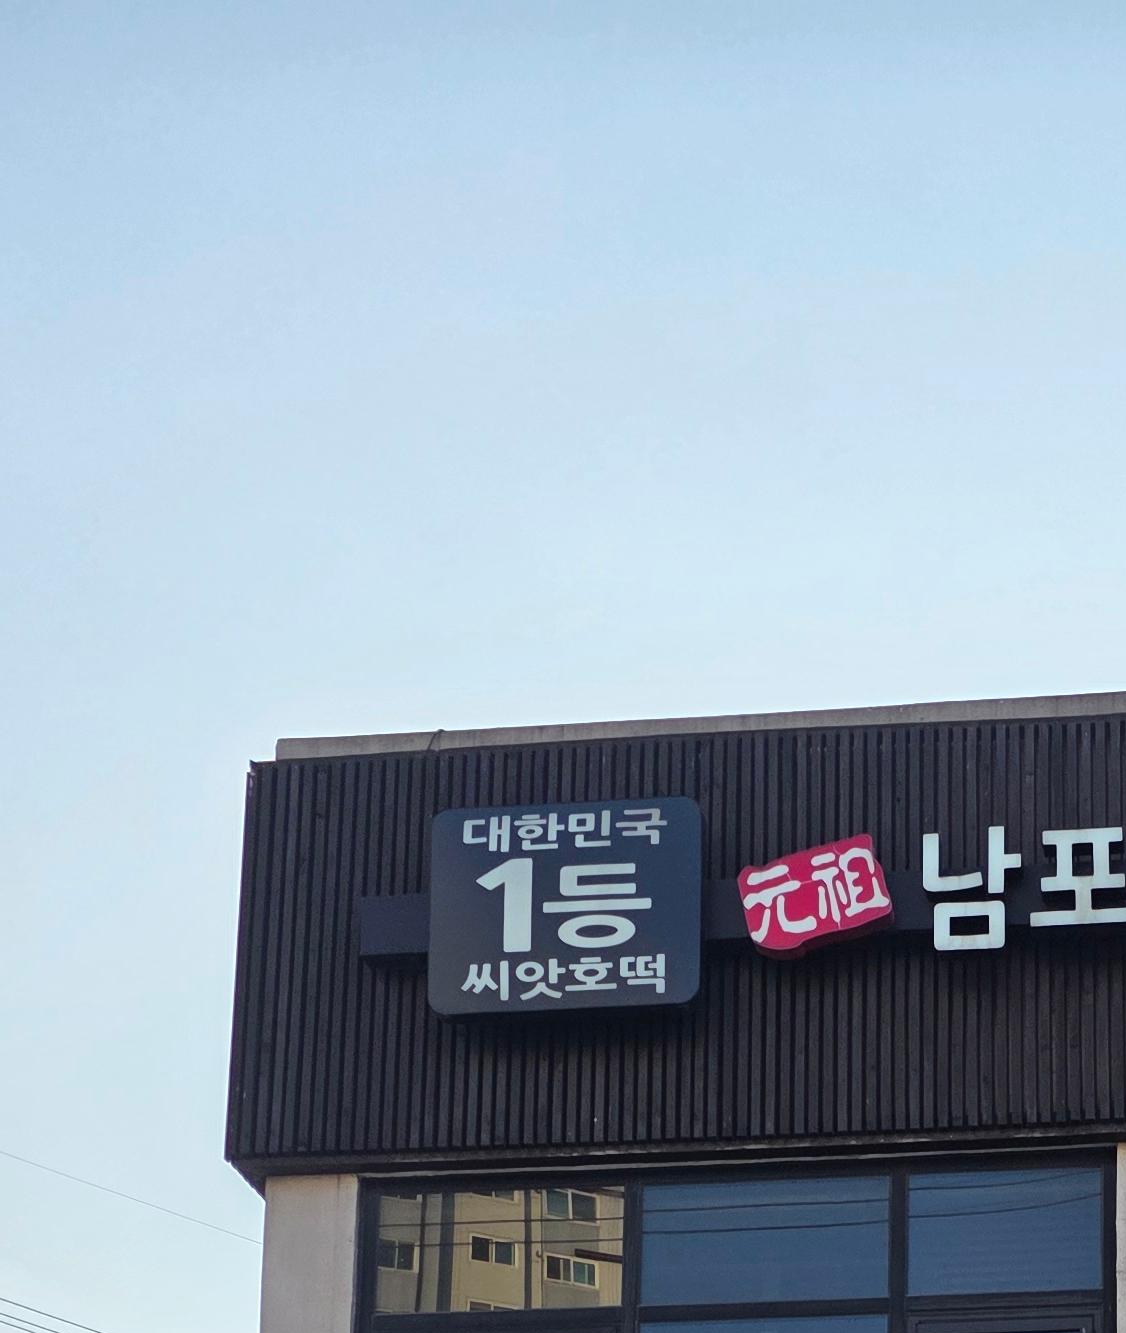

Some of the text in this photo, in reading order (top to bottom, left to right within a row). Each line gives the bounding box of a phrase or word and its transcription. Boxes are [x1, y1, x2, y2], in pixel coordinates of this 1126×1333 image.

[461, 806, 669, 854] 대한민국
[475, 856, 653, 954] 1등
[742, 844, 892, 938] 元祖
[460, 952, 668, 1002] 씨앗호떡
